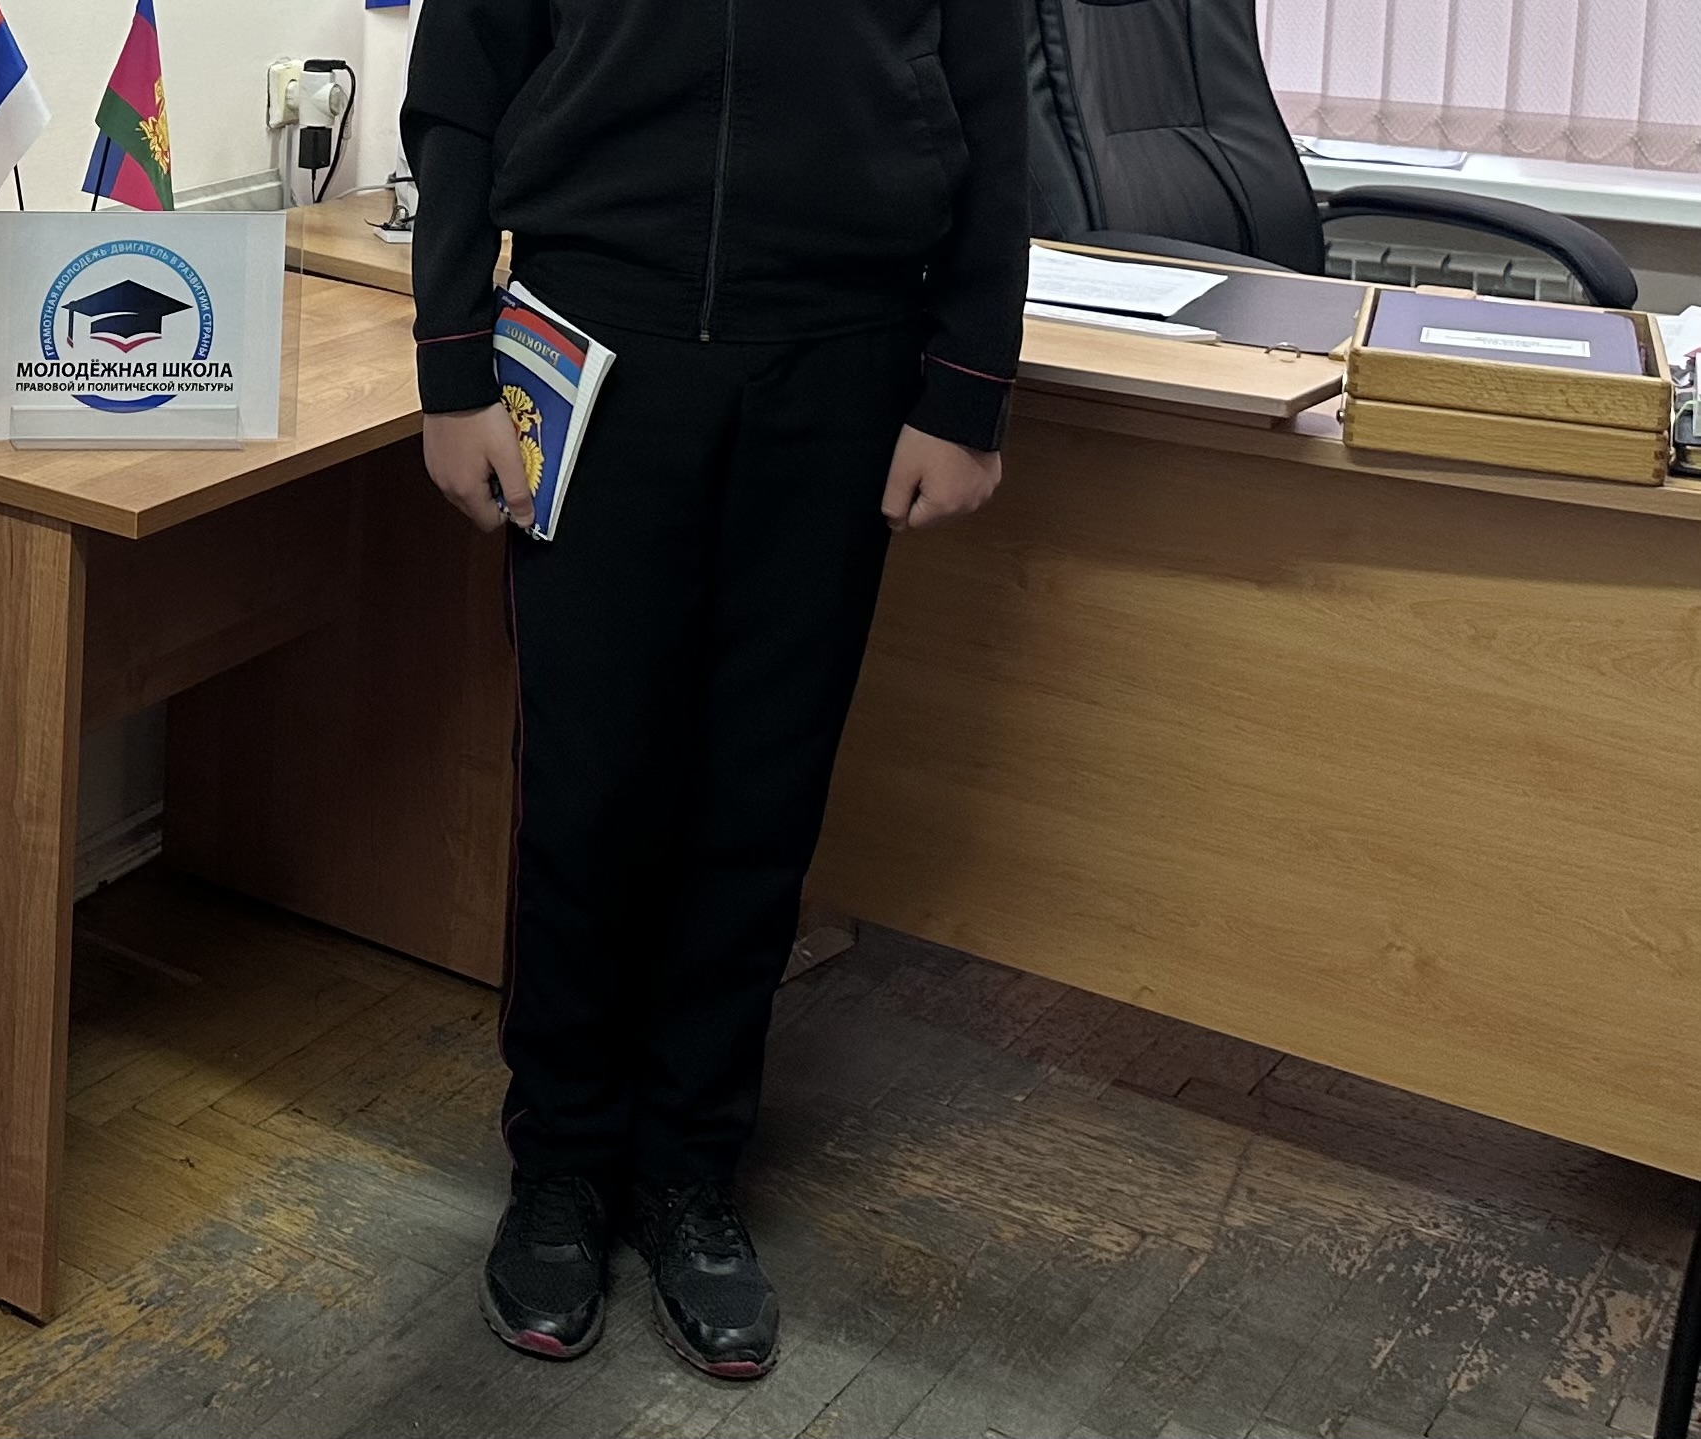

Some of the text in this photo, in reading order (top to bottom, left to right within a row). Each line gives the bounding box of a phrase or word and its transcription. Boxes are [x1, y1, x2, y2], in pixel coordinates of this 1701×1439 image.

[42, 242, 213, 358] ГРАМОТНАЯ МОЛОДЕЖЬ ДВИГАТЕЛЬ В РАЗВИТИИ СТРАНЫ
[505, 324, 561, 367] Блокнот
[16, 359, 233, 381] МОЛОДЁЖНАЯ ШКОЛА
[15, 380, 234, 393] ПРАВОВОЙ И ПОЛИТИЧЕСКОЙ КУЛЬТУРЫ
